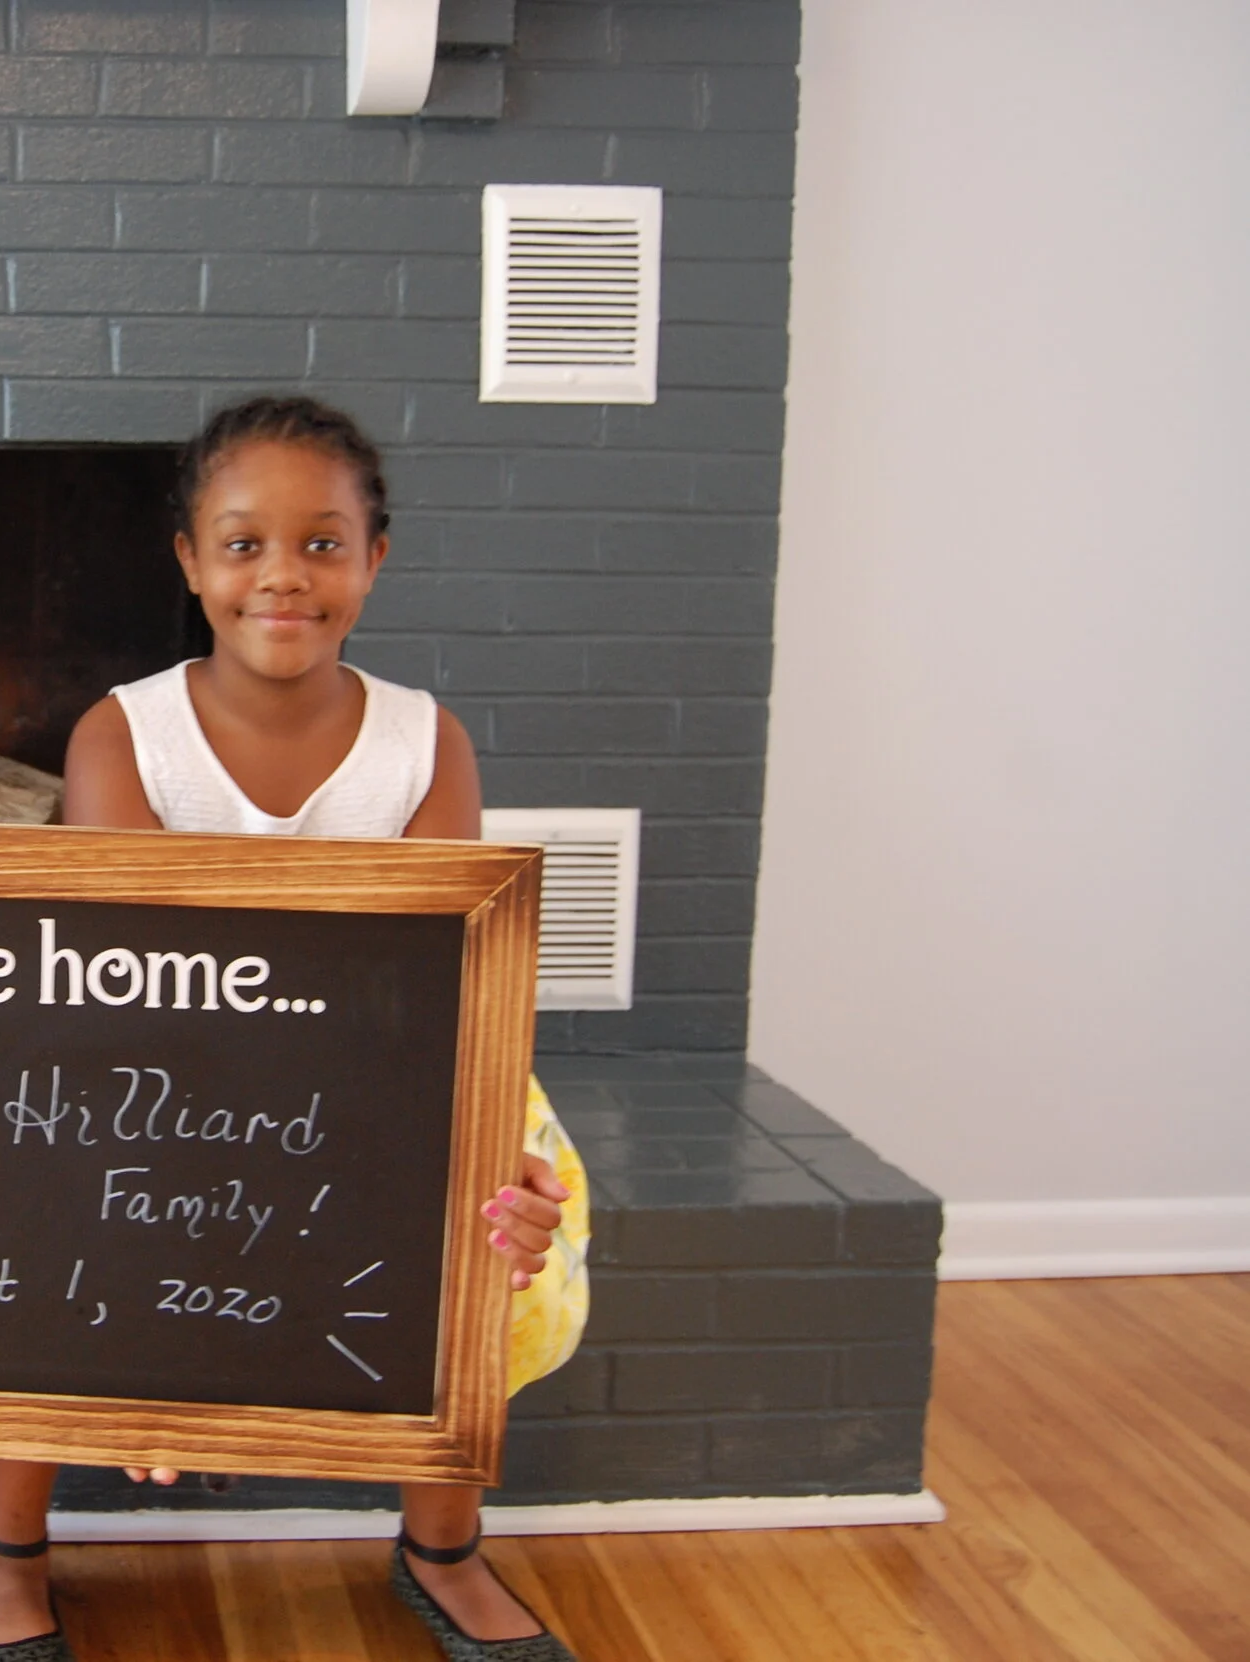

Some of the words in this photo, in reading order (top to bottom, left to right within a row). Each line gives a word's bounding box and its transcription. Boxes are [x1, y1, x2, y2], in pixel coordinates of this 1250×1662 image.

[38, 917, 327, 1014] home...
[3, 1064, 325, 1155] Hilliard
[156, 1278, 282, 1324] 2020
